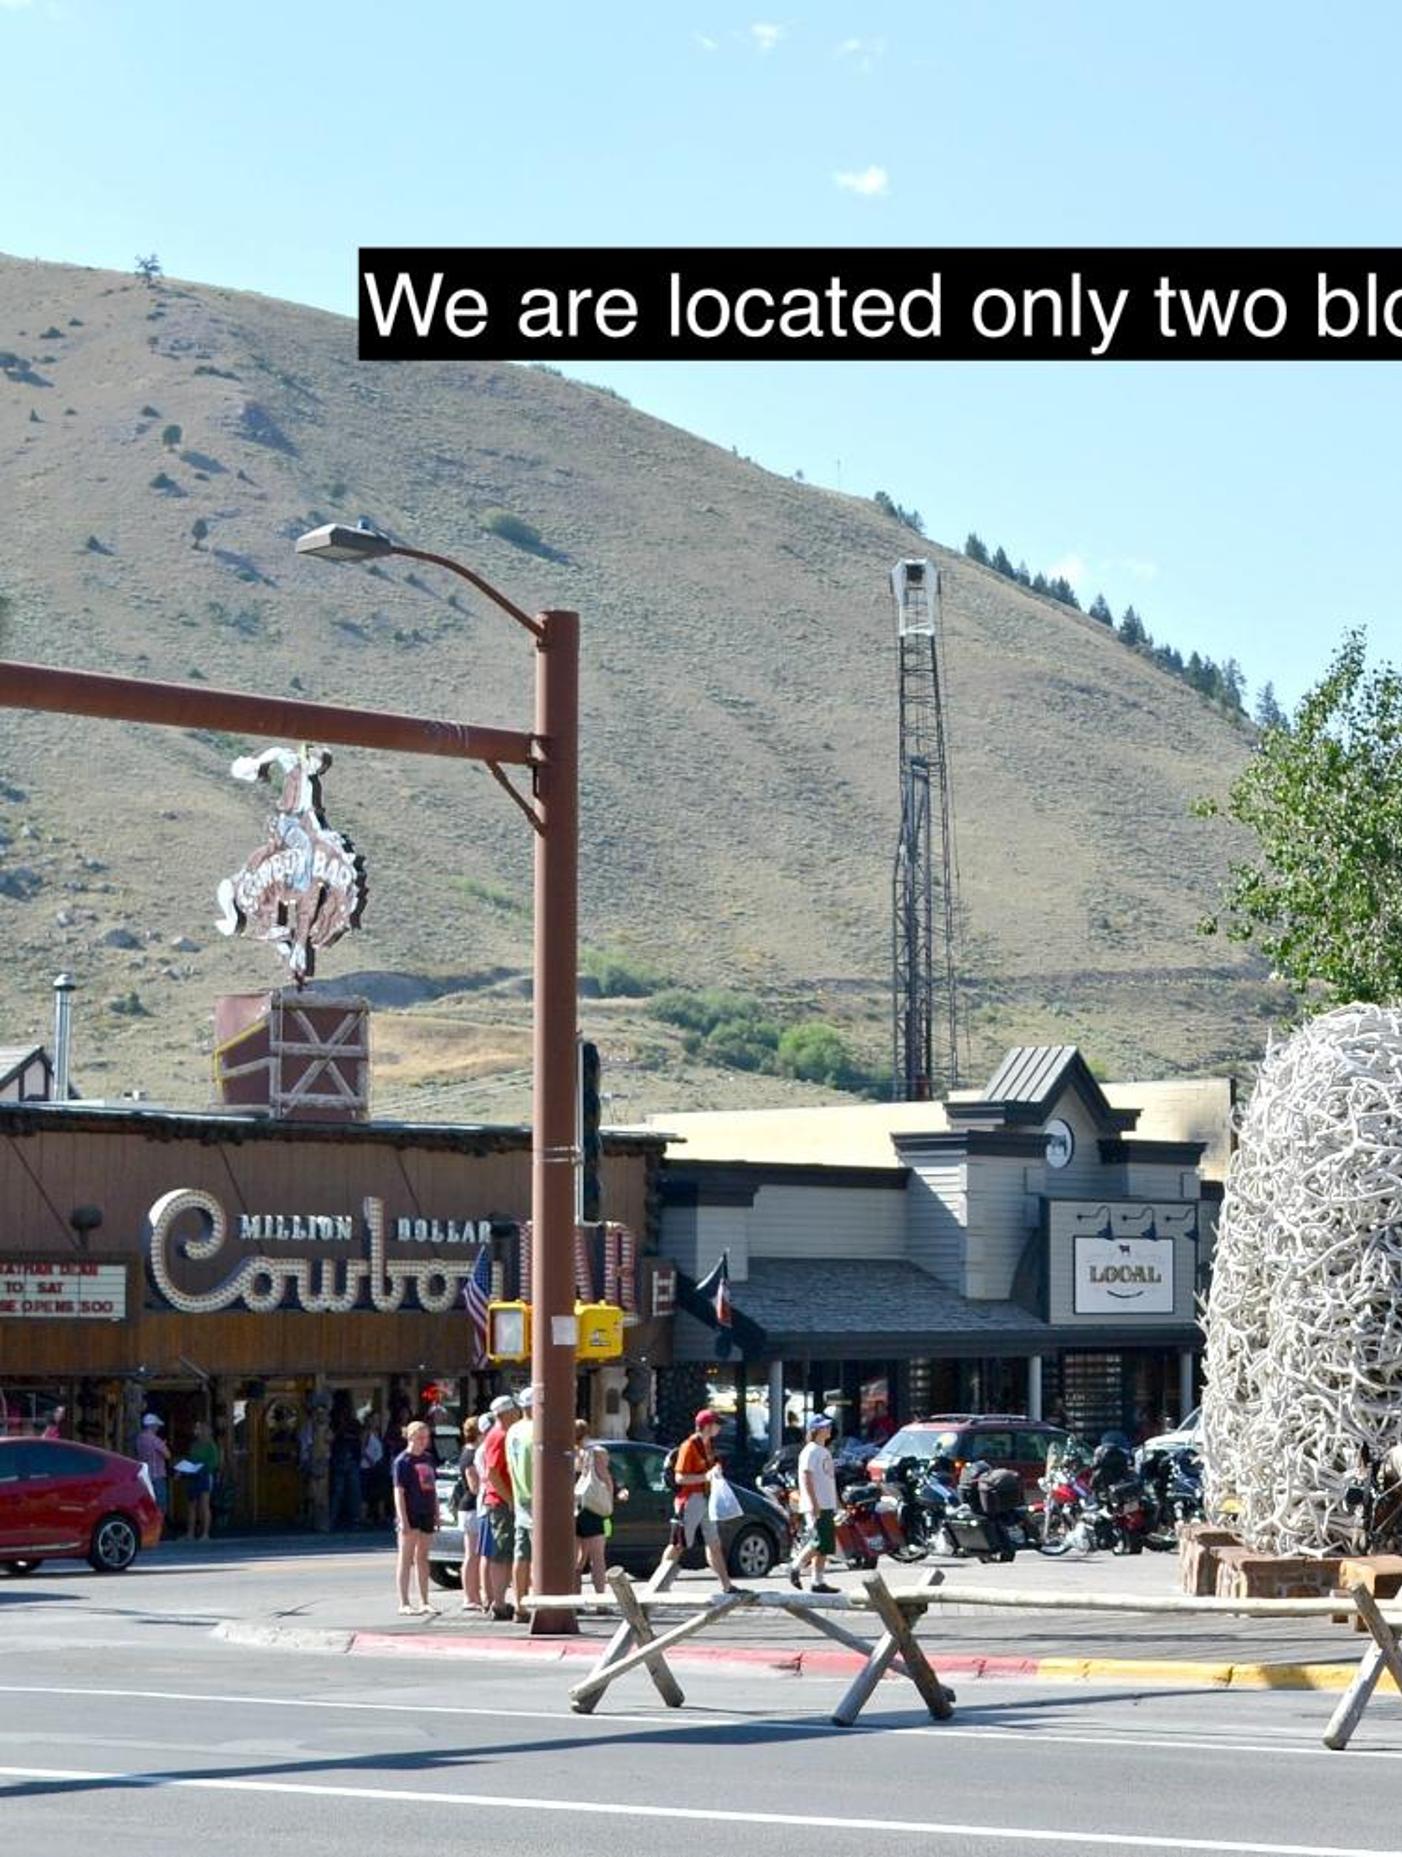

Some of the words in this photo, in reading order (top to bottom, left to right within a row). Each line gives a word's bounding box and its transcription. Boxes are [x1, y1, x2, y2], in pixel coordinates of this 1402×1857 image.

[239, 1214, 352, 1241] MILLION
[397, 1217, 492, 1244] DOLLAR
[1089, 1265, 1162, 1284] LOCAL
[37, 1281, 63, 1294] SAT
